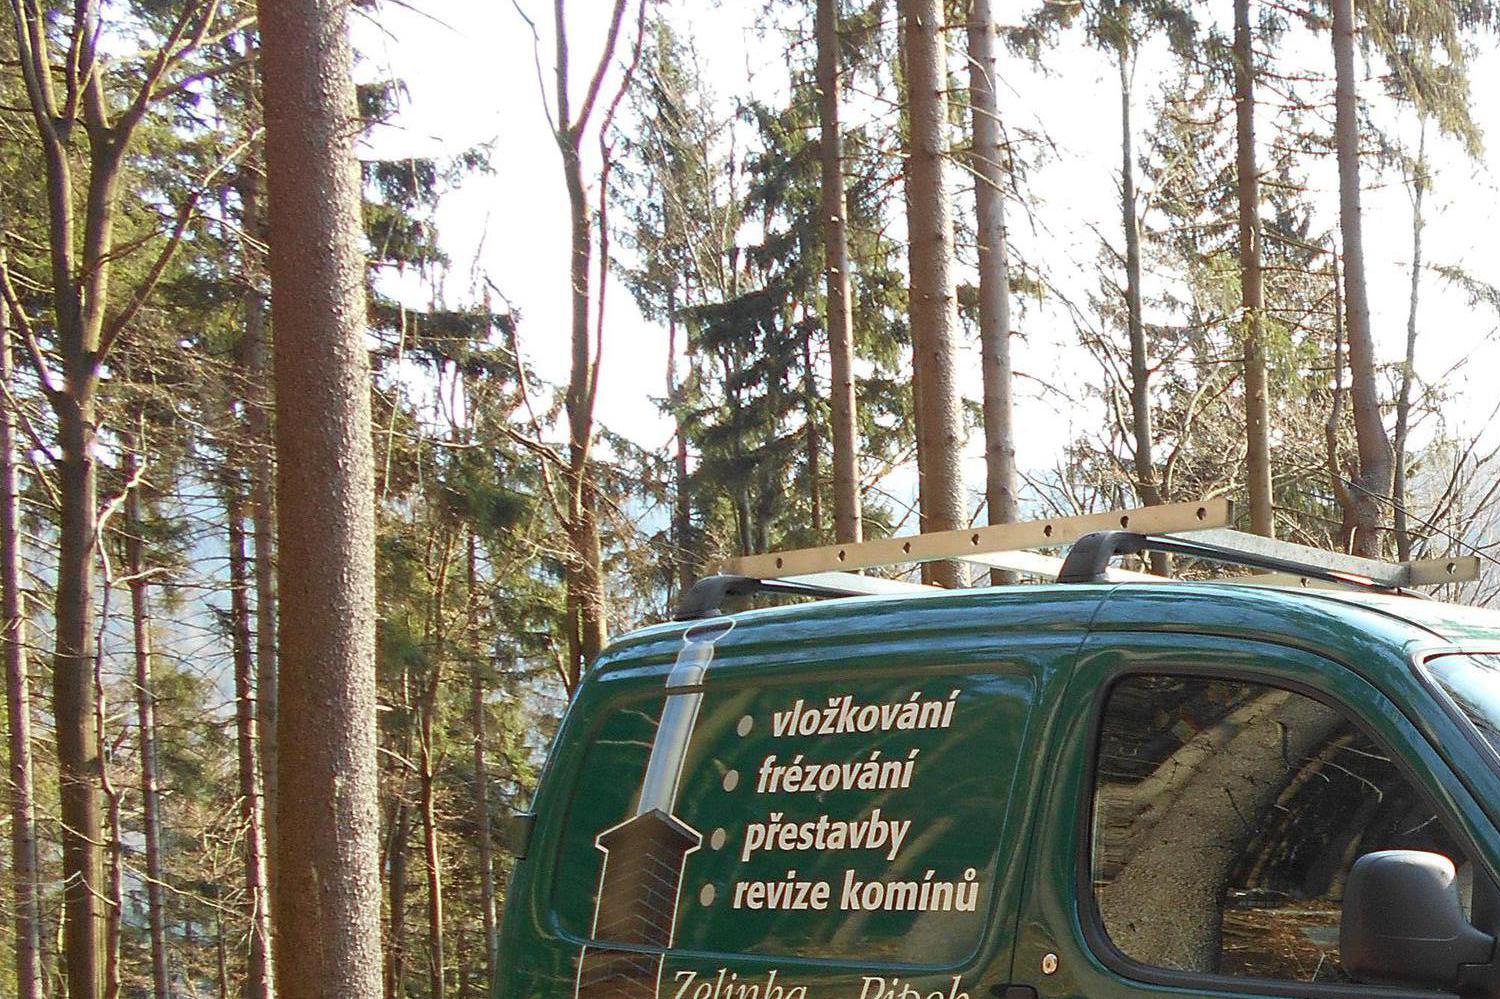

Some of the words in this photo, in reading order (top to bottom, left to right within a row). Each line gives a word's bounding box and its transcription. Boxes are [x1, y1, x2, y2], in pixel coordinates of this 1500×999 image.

[773, 689, 961, 737] vložkování
[757, 748, 920, 793] frézování
[741, 808, 912, 862] přestavby
[733, 870, 831, 910] revize
[840, 867, 980, 912] komínů
